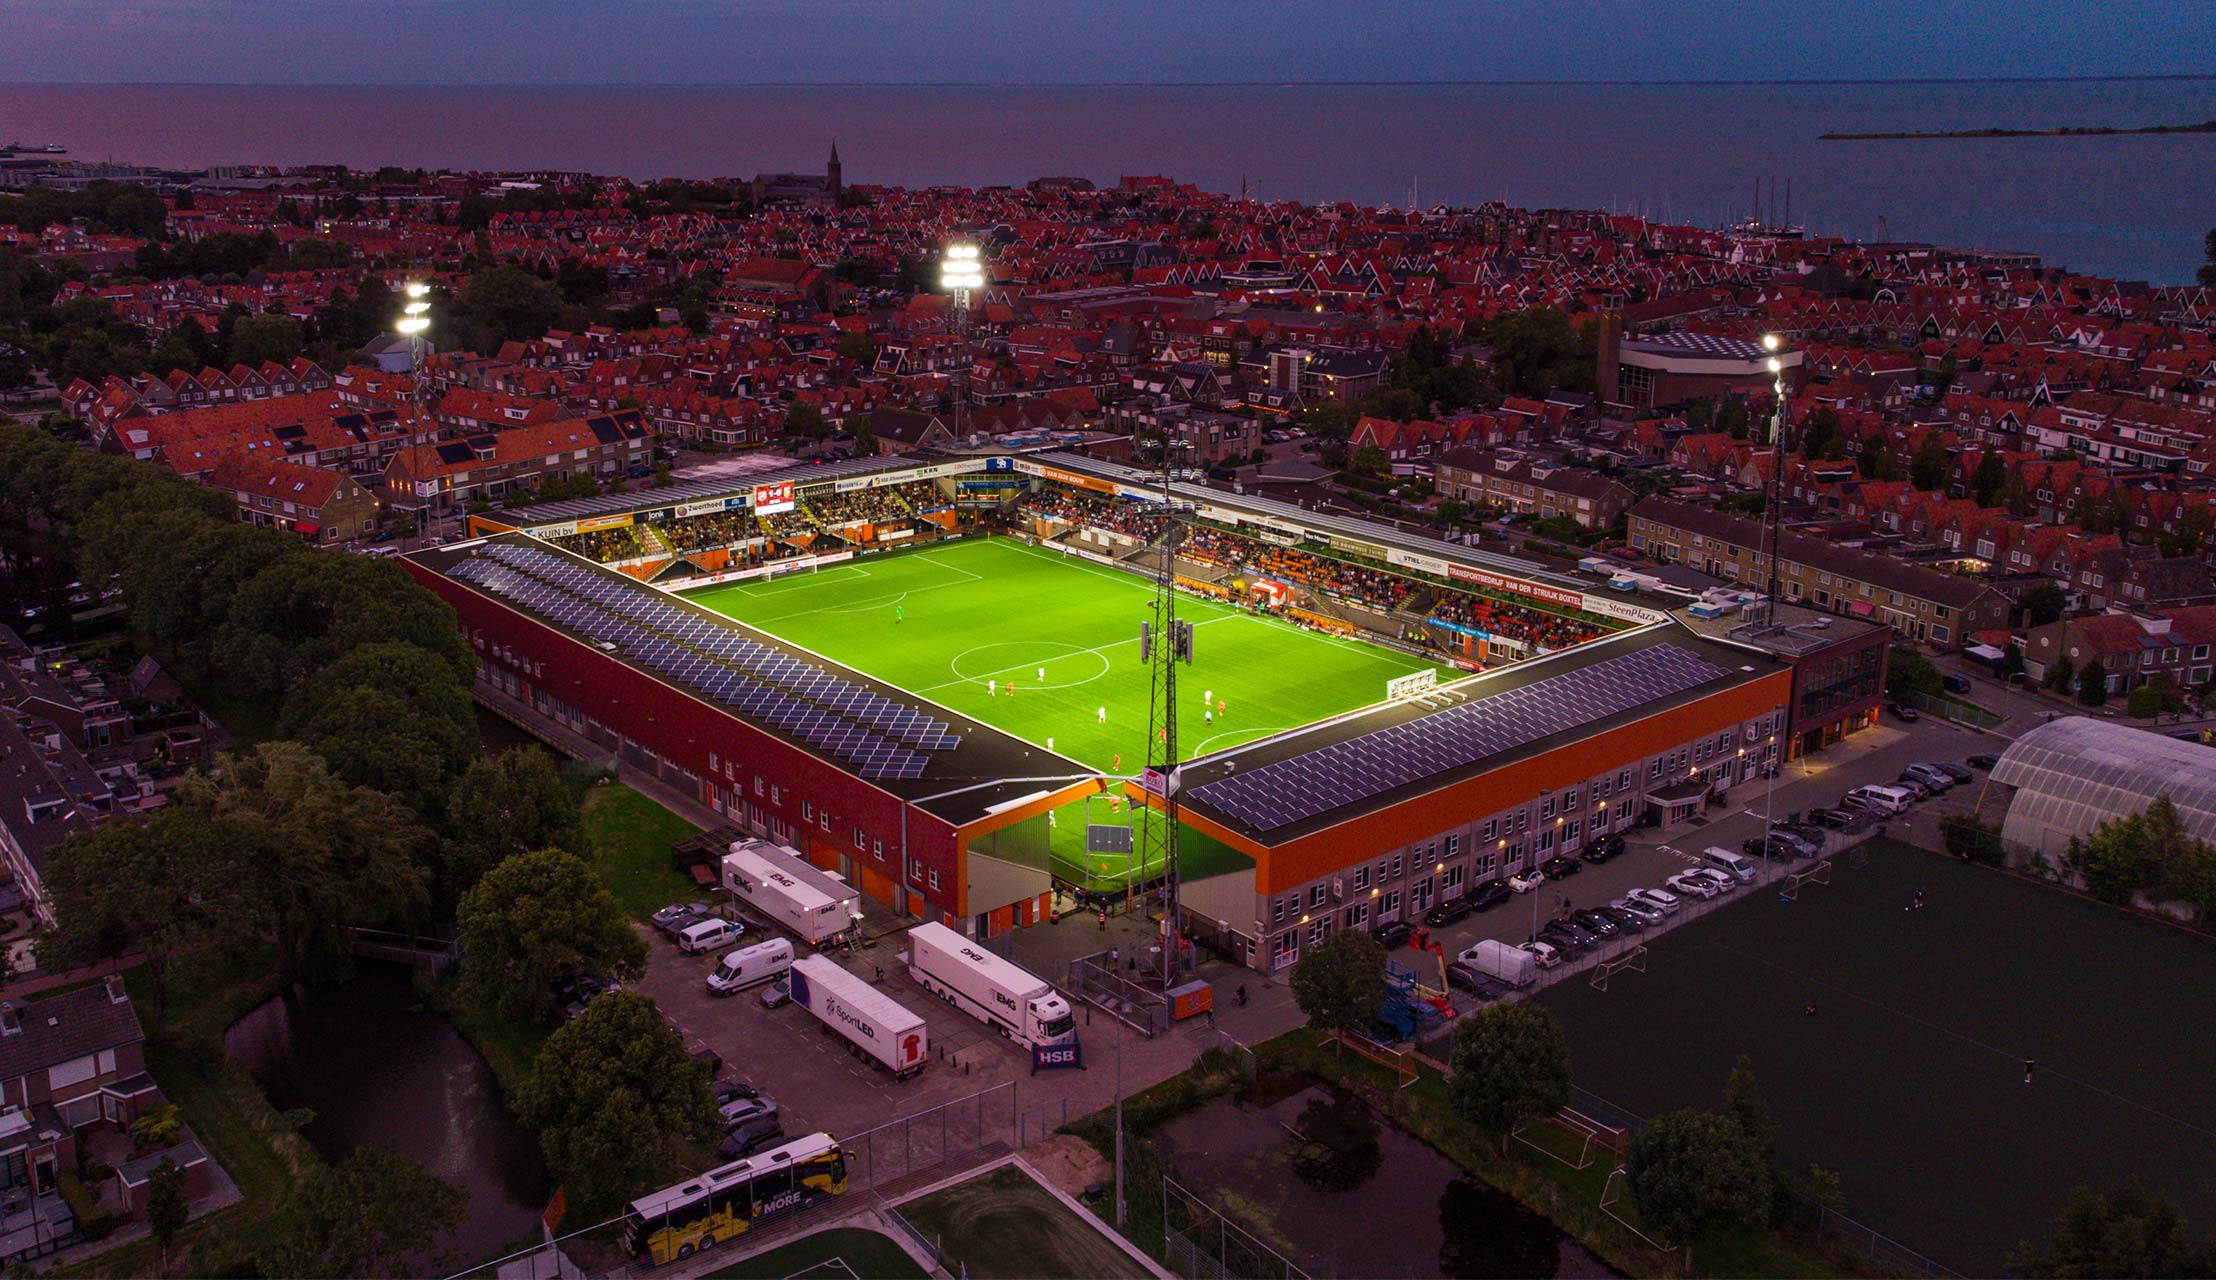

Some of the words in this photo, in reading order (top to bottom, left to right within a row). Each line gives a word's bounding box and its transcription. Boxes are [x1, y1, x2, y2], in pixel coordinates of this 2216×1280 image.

[1047, 470, 1058, 478] VAN
[537, 528, 560, 540] KUIN
[562, 527, 574, 536] bv
[1449, 567, 1504, 586] TRANSPORTBEDRIJF
[1505, 581, 1518, 591] VAN
[1519, 584, 1531, 593] DER
[1533, 587, 1557, 600] STRUIJK
[1558, 593, 1582, 606] BOXTEL
[1608, 602, 1655, 621] SteenPlaza
[733, 873, 752, 894] EMG
[770, 873, 795, 887] EMG
[820, 904, 836, 915] EMG
[771, 952, 788, 963] EMG
[960, 947, 984, 962] EMG
[996, 992, 1017, 1011] EMG
[836, 1005, 874, 1038] SportLED
[1040, 1050, 1074, 1063] HSB
[763, 1191, 801, 1215] MORE
